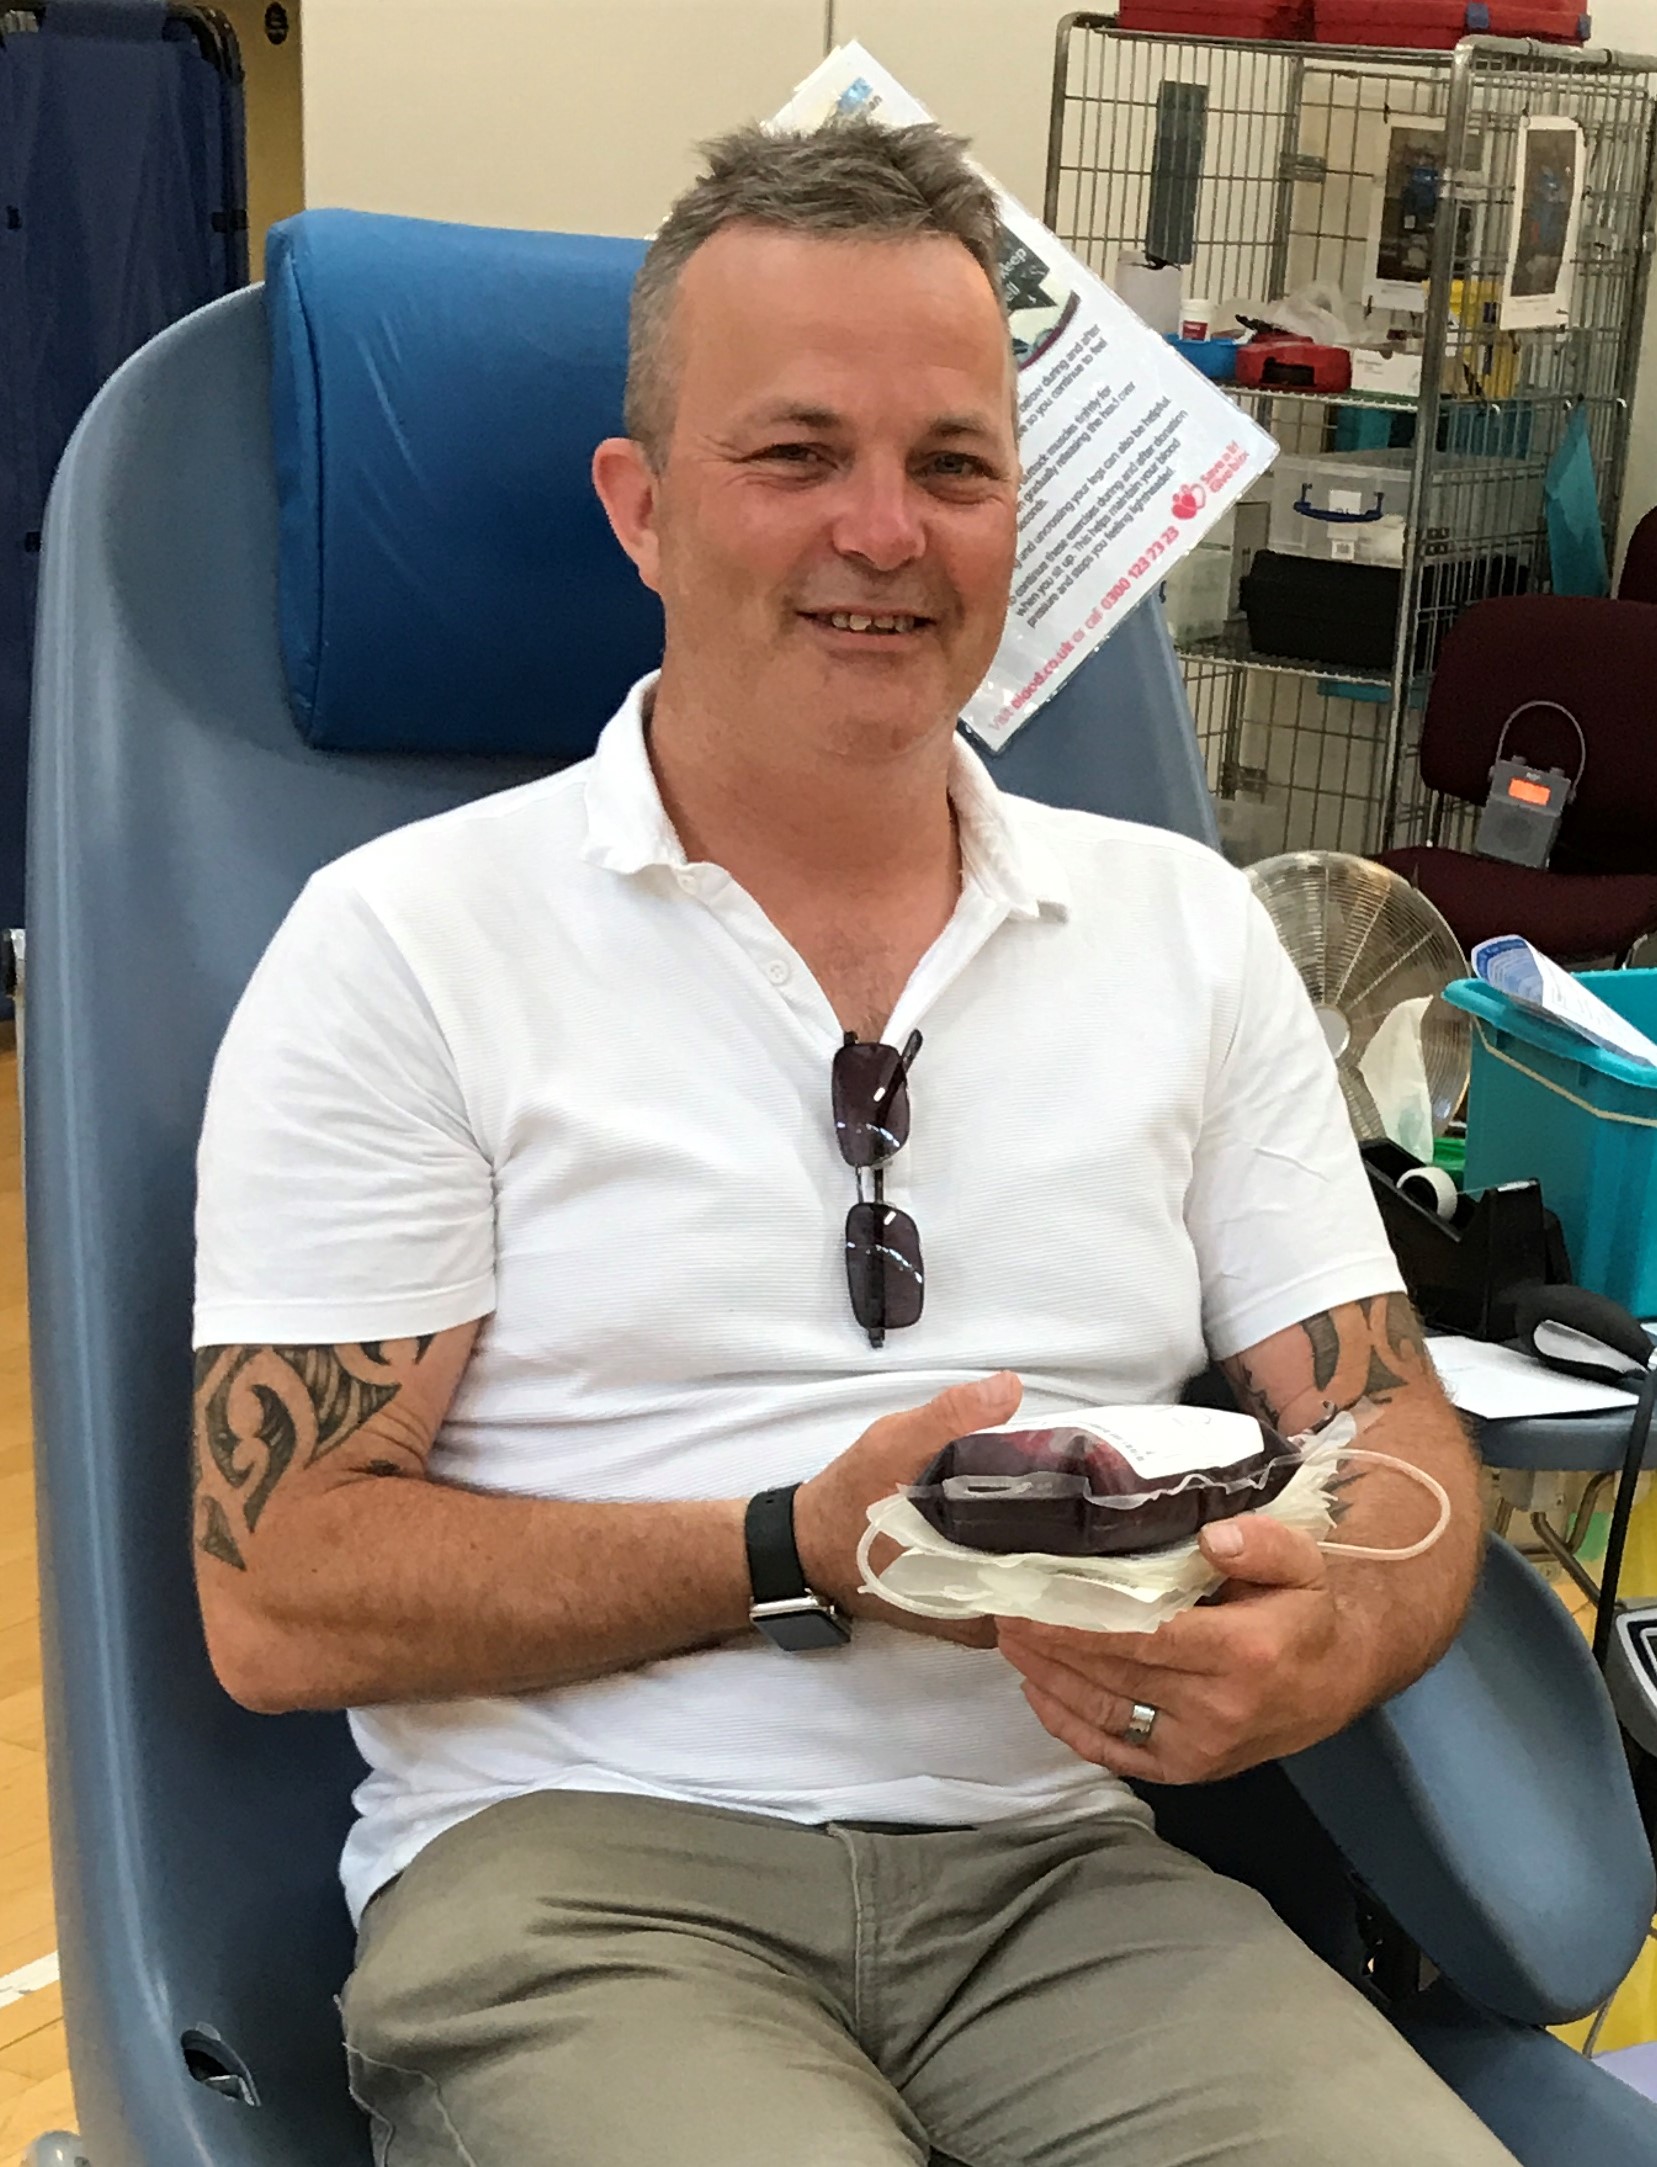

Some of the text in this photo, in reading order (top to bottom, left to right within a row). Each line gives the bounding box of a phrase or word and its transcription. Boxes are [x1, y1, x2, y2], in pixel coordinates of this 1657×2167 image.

[1063, 340, 1084, 362] and
[1101, 451, 1120, 470] can
[1129, 421, 1146, 438] be
[1154, 436, 1182, 465] blood
[1118, 460, 1139, 482] and
[1097, 575, 1133, 612] 0300
[1125, 554, 1152, 581] 123
[1159, 523, 1181, 545] 23
